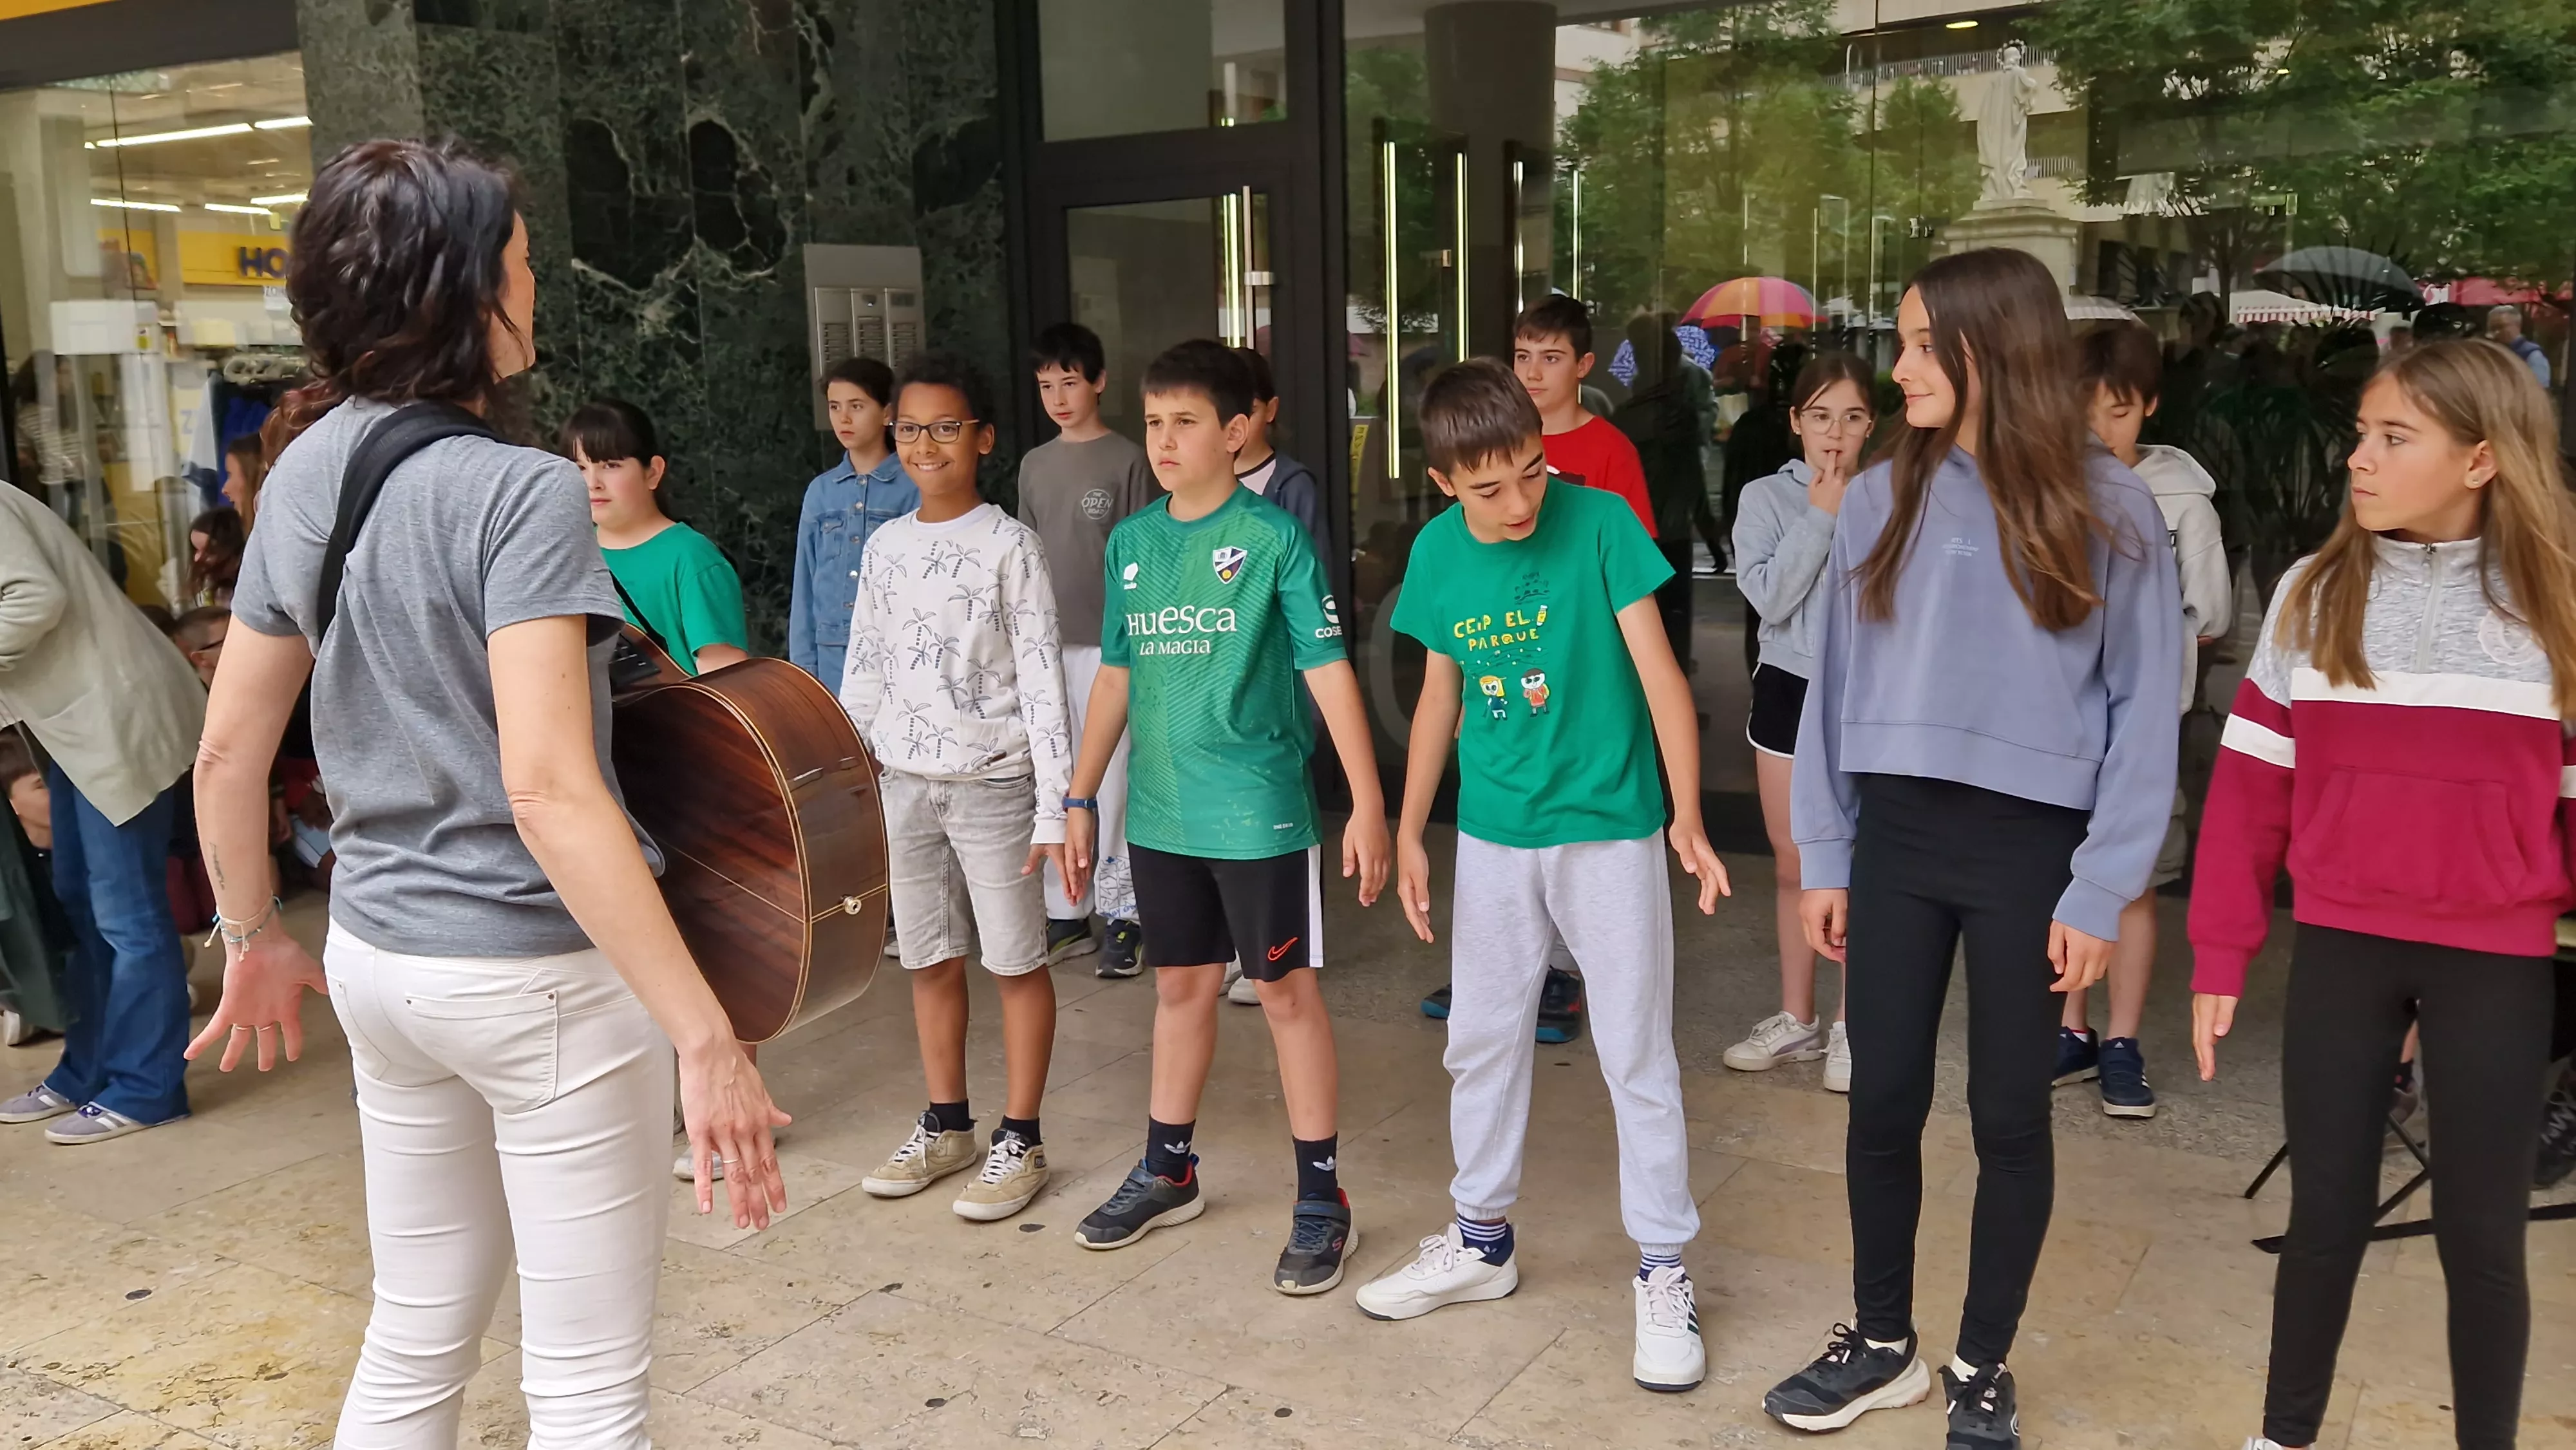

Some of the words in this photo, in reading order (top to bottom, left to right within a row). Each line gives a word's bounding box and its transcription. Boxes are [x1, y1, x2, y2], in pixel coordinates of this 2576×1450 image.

[1081, 497, 1113, 508] OPEN
[1505, 609, 1531, 627] EL
[1468, 628, 1539, 652] PARQUE
